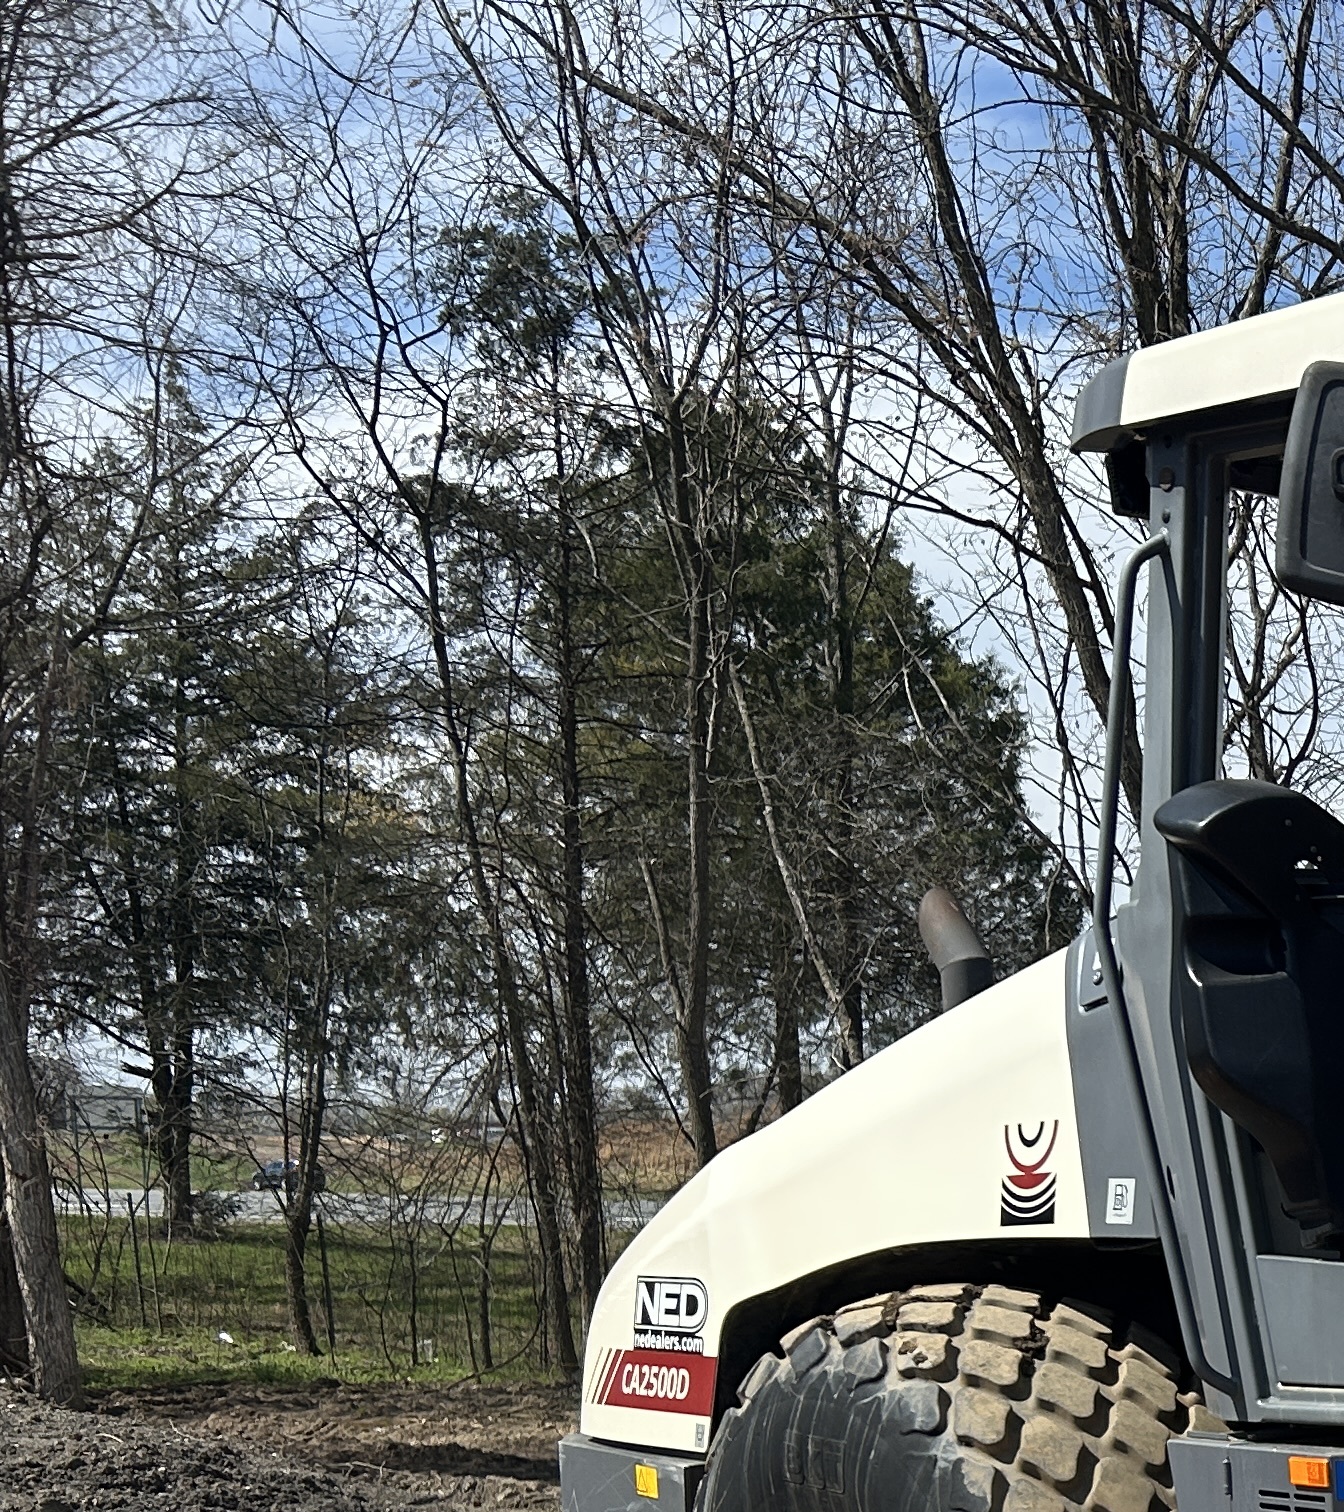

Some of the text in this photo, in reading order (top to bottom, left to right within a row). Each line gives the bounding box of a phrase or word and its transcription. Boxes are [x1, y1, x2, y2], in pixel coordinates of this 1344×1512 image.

[635, 1281, 706, 1328] NED
[634, 1330, 703, 1353] nedealers.com
[621, 1363, 690, 1400] CA2500D
